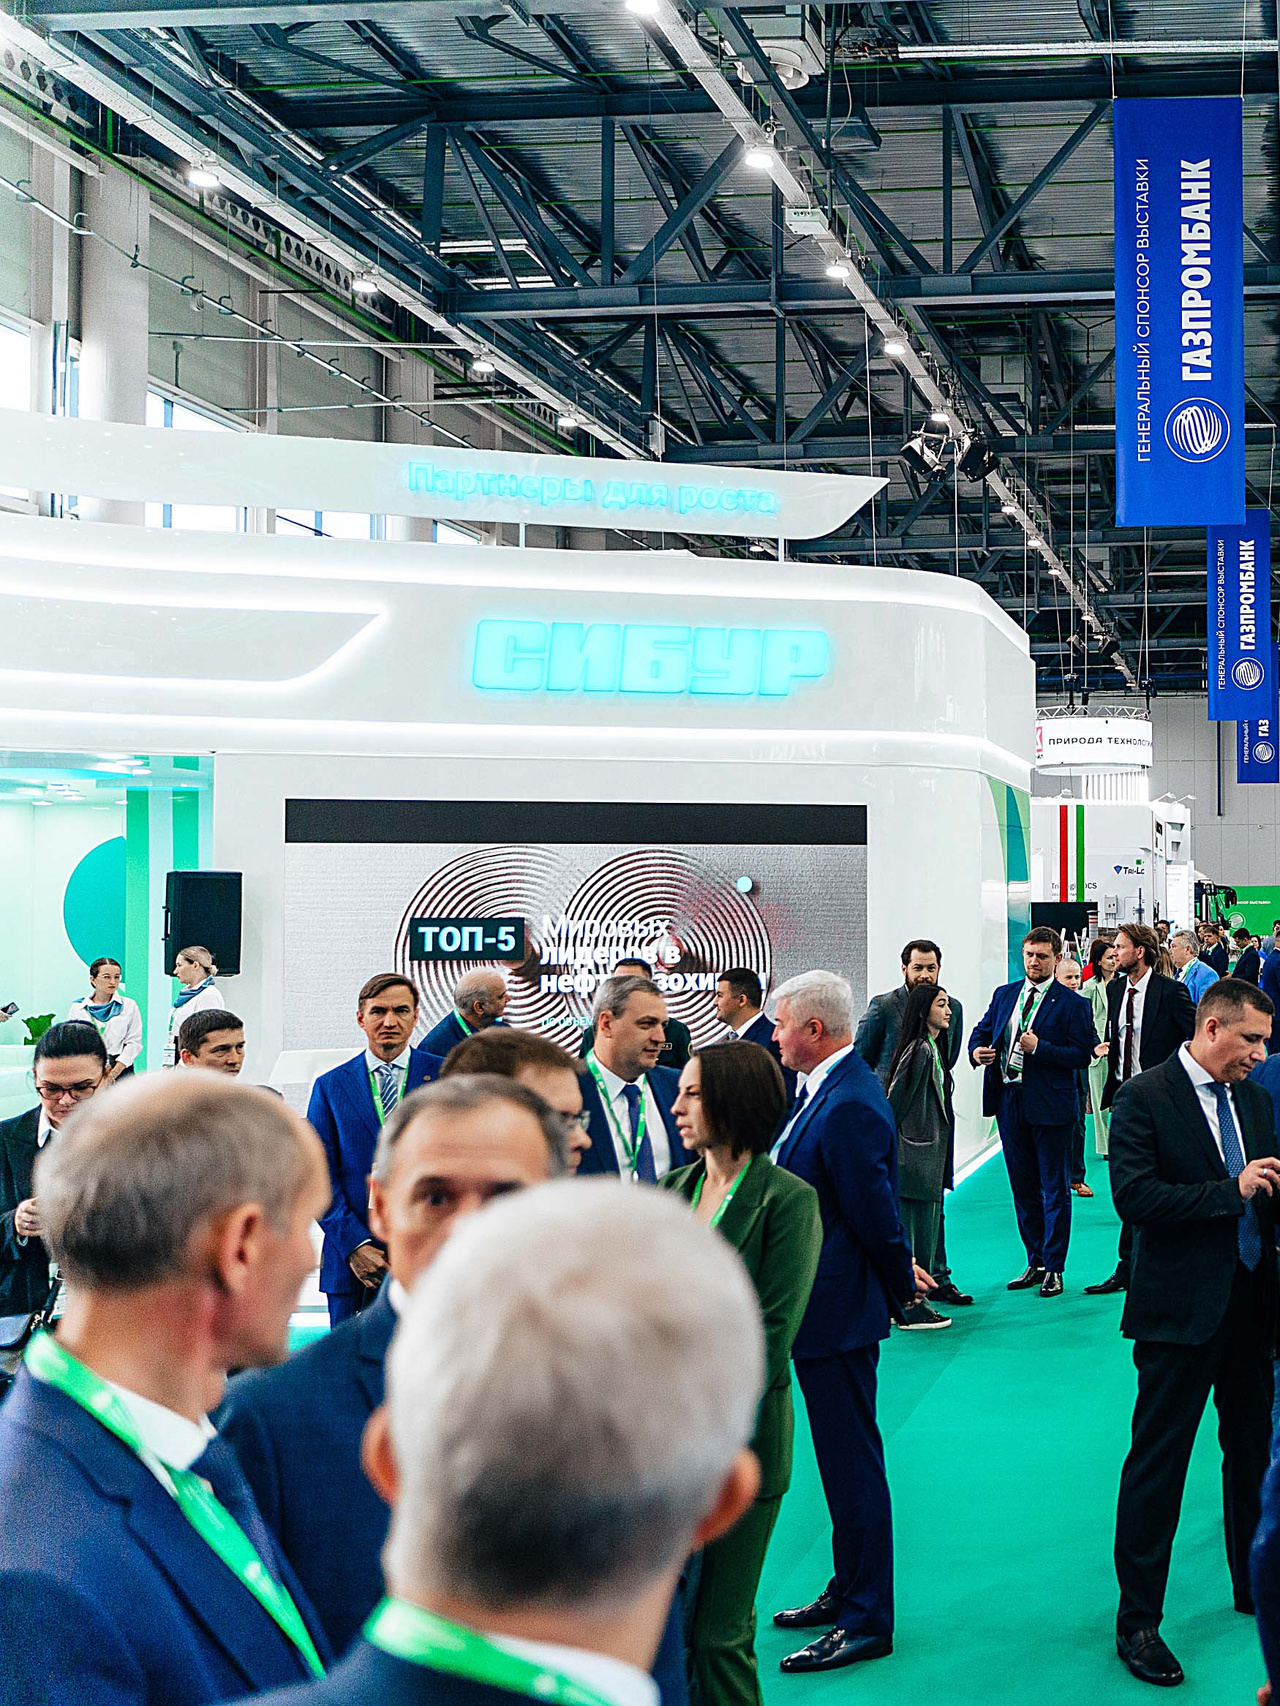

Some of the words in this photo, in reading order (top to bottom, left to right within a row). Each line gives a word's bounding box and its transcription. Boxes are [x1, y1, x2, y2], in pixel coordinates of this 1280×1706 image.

[1136, 159, 1150, 248] ВЫСТАВКИ
[1136, 253, 1150, 338] СПОНСОР
[1180, 158, 1212, 381] ГАЗПРОМБАНК
[1132, 343, 1150, 462] ГЕНЕРАЛЬНЫЙ
[408, 462, 592, 505] Партнеры
[603, 480, 669, 509] для
[679, 484, 777, 514] роста
[1217, 539, 1226, 584] ВЫСТАВКИ
[1217, 586, 1226, 629] СПОНСОР
[1239, 539, 1255, 650] ГАЗПРОМБАНК
[472, 619, 828, 696] СИБУР
[1216, 631, 1226, 690] ГЕНЕРАЛЬНЫЙ
[1048, 737, 1103, 746] ПРИРОДА
[418, 926, 516, 952] ТОП-5
[541, 914, 671, 941] Мировых
[540, 946, 659, 969] лидеров
[665, 948, 681, 963] в
